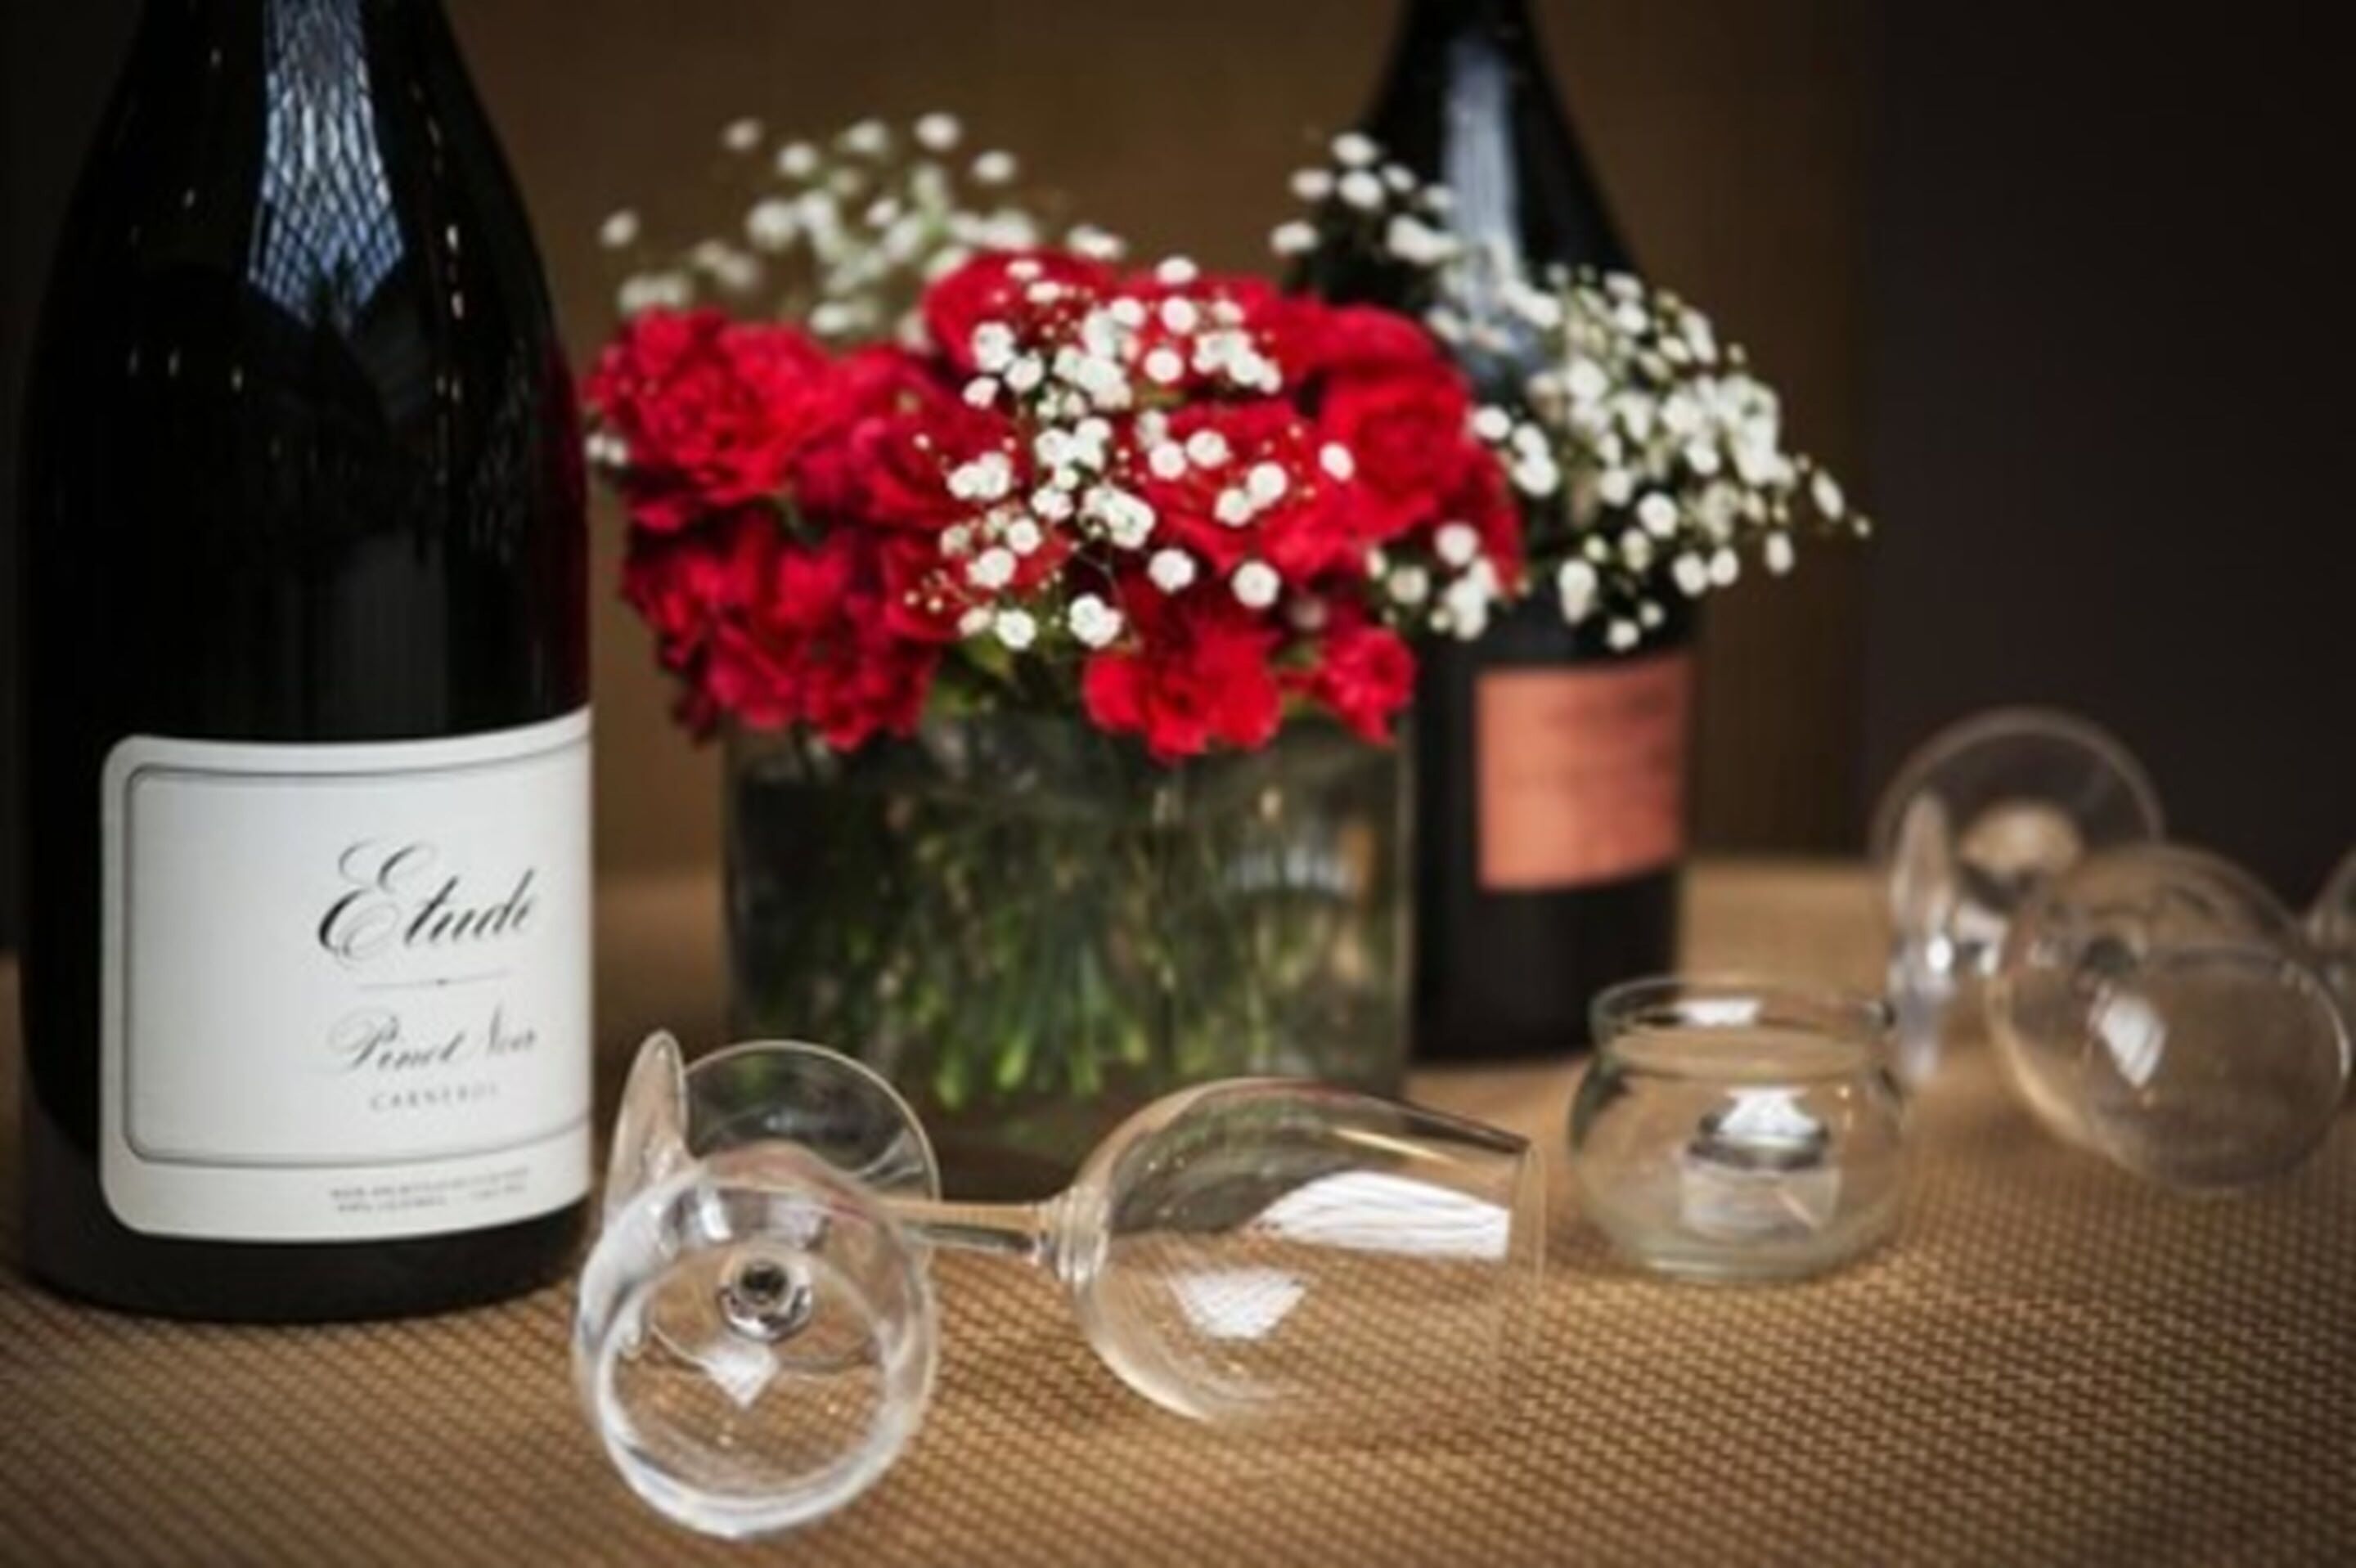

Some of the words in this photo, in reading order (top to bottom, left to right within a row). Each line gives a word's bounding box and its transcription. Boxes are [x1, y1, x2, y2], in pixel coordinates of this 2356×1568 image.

[317, 840, 537, 968] Etude
[326, 1006, 466, 1075] Pinot
[479, 1001, 537, 1059] Noir
